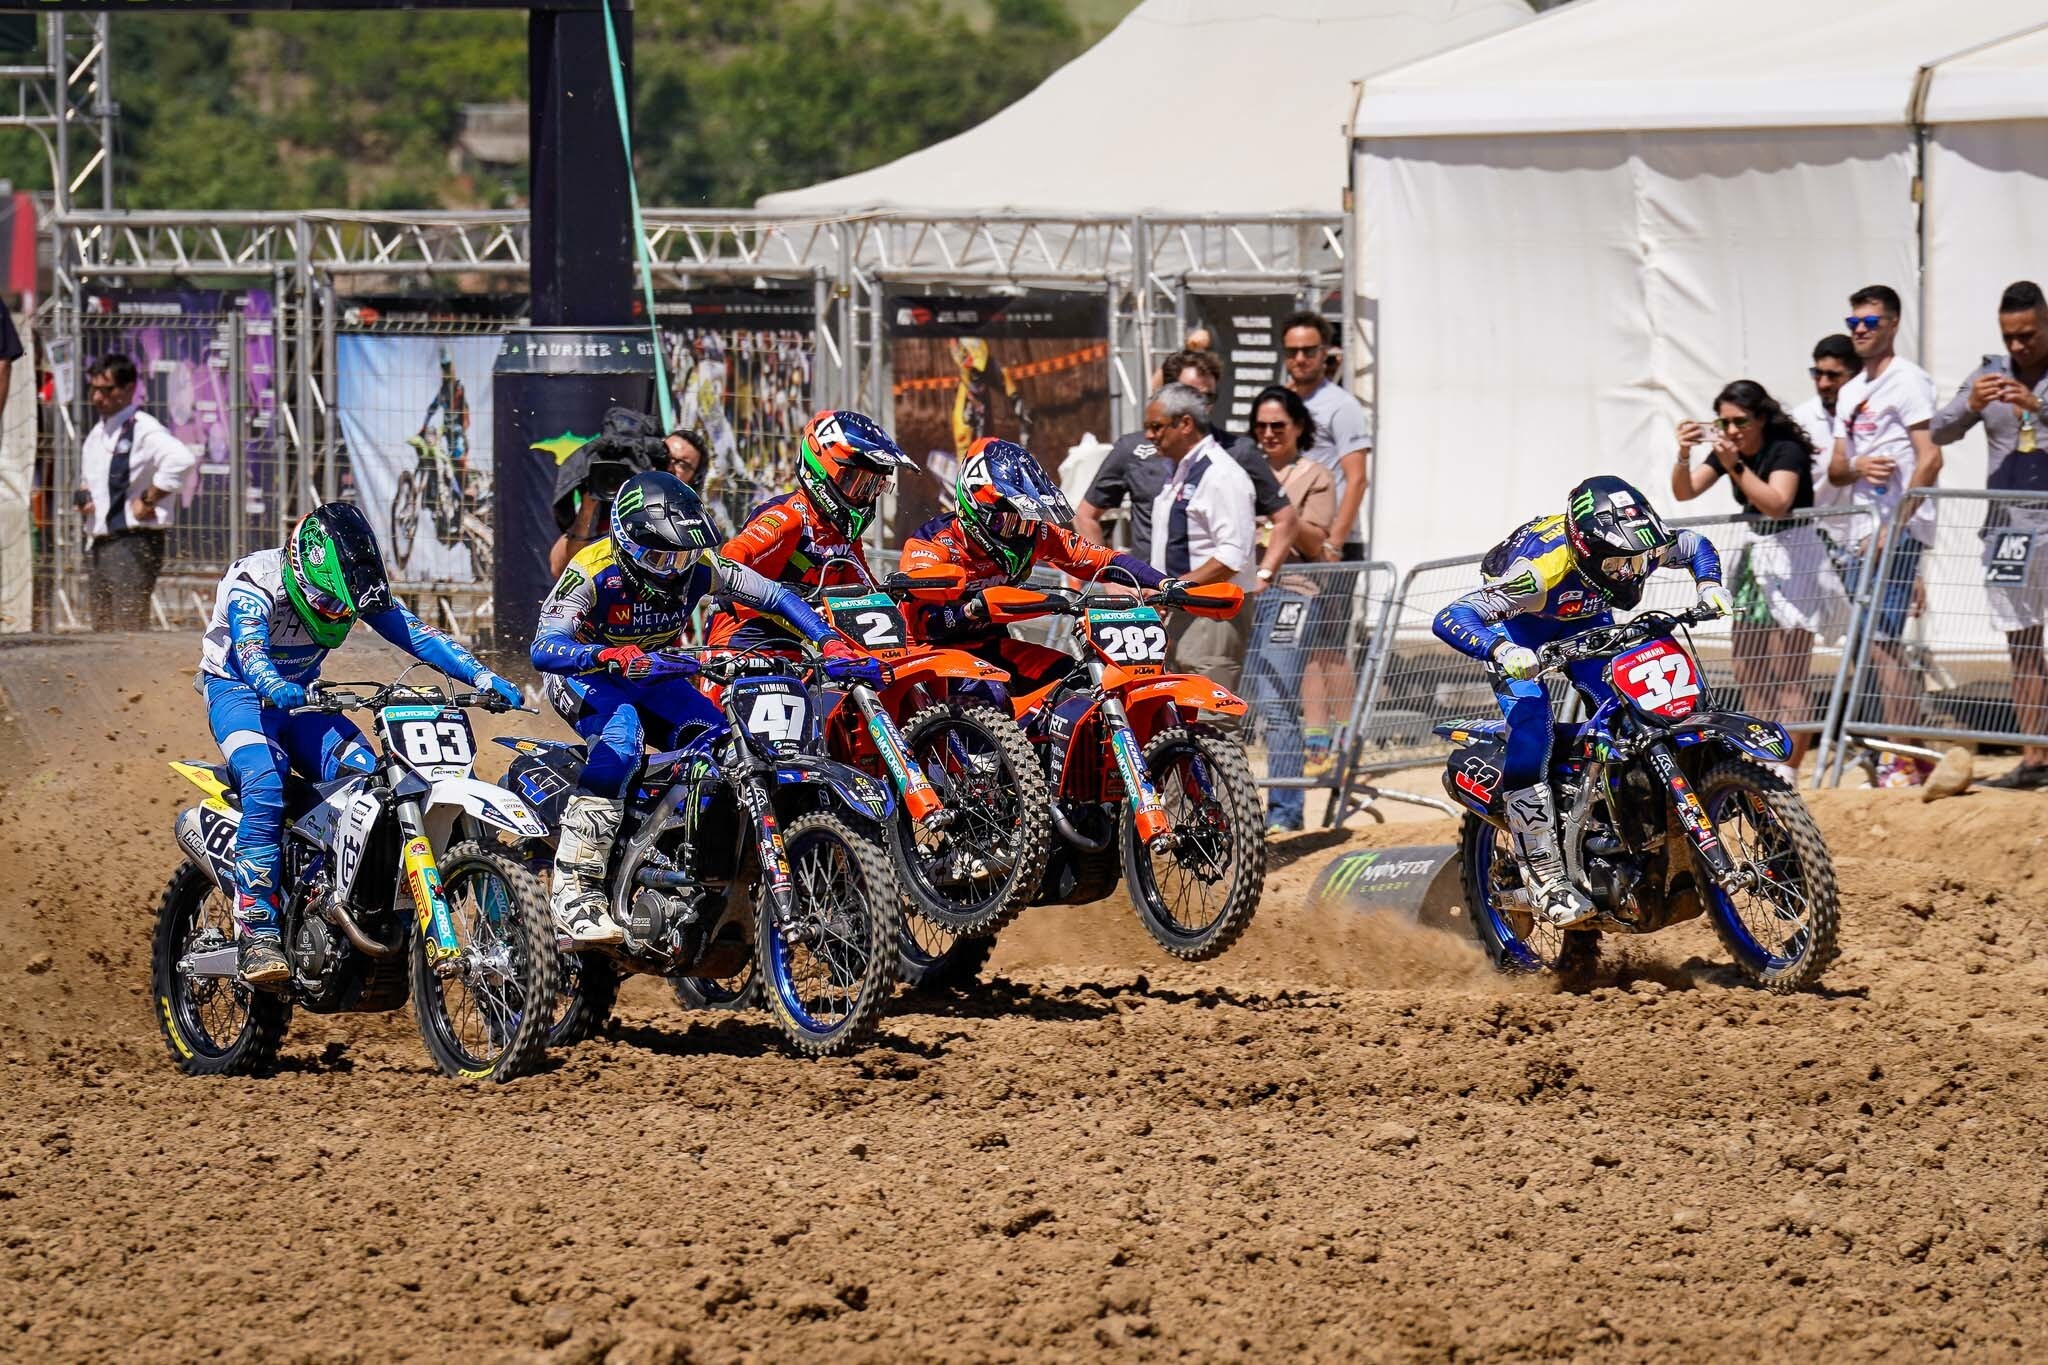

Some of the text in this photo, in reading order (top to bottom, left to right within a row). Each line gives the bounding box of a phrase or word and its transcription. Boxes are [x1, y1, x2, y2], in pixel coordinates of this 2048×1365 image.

[841, 599, 873, 608] MOTOREX
[1100, 612, 1136, 620] MOTOREX
[855, 612, 899, 645] 2
[1100, 626, 1166, 660] 282
[1635, 646, 1666, 662] YAMAHA
[1134, 667, 1155, 675] KTM
[1628, 654, 1700, 711] 32
[759, 683, 790, 693] YAMAHA
[395, 708, 440, 718] MOTOREX
[748, 693, 806, 741] 47
[402, 722, 472, 763] 83
[877, 736, 906, 783] MOTOREX
[1116, 754, 1139, 800] MOTOREX
[184, 832, 207, 858] HGS
[1360, 859, 1435, 881] MONSTER
